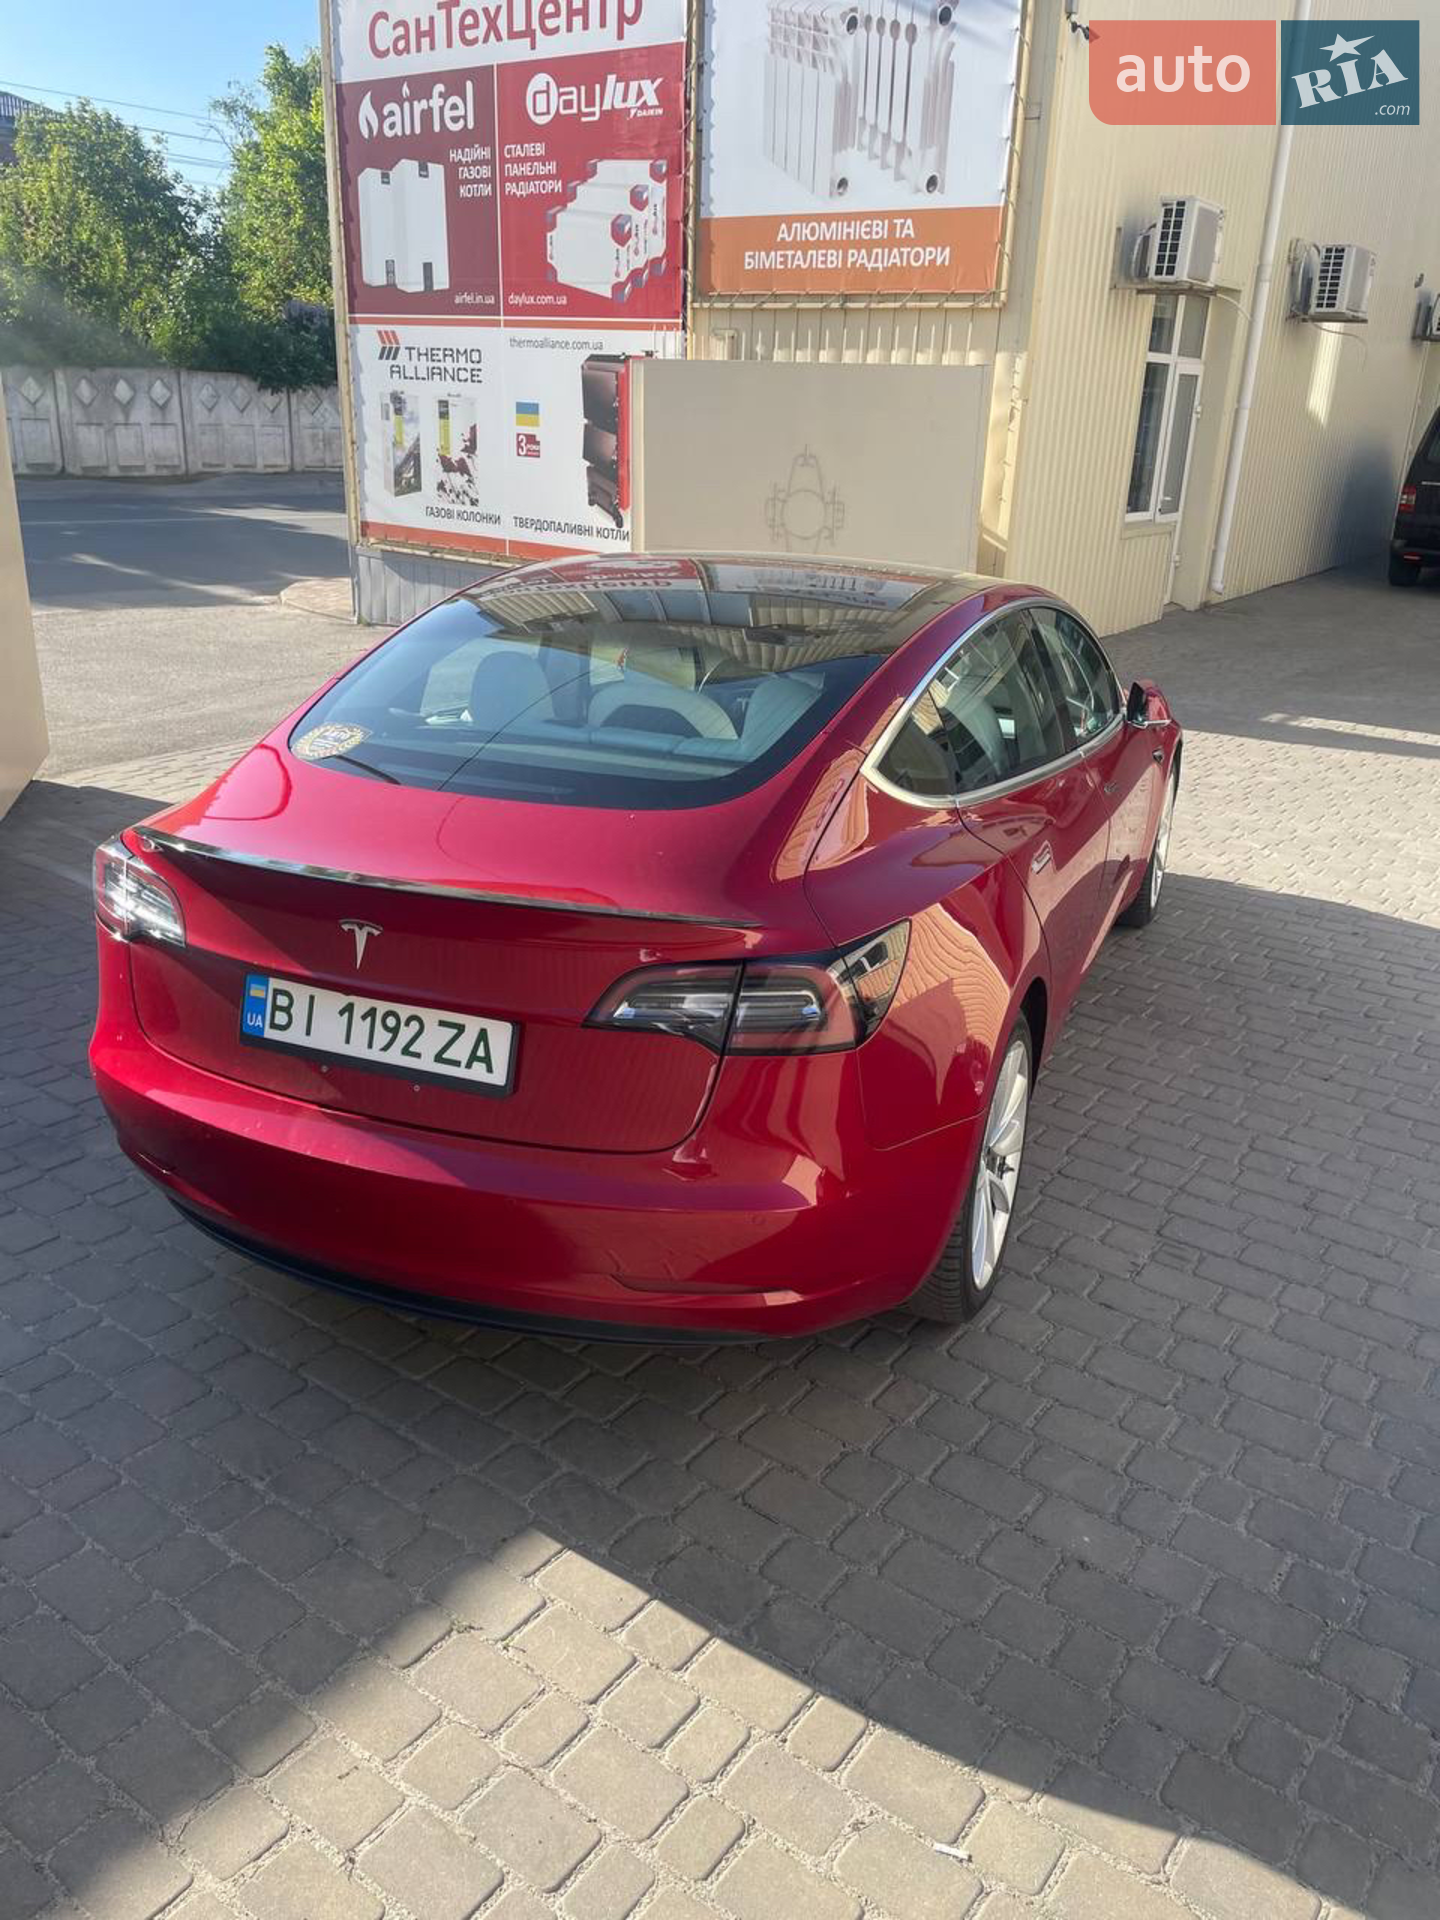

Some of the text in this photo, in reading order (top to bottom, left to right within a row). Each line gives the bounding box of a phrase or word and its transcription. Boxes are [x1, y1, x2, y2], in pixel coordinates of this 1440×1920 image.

[368, 0, 642, 59] СанТехЦентр
[526, 73, 663, 125] daylux
[382, 81, 474, 138] airfel
[449, 144, 491, 164] НАДІЙНІ
[503, 143, 545, 158] СТАЛЕВІ
[458, 166, 491, 179] ГАЗОВІ
[504, 161, 556, 177] ПАНЕЛЬНІ
[460, 183, 492, 198] КОТЛИ
[504, 179, 562, 198] РАДІАТОРИ
[776, 218, 915, 242] АЛЮМІНІЄВІ ТА
[743, 246, 950, 271] БІМЕТАЛЕВІ РАДІАТОРИ
[507, 292, 568, 306] daylux.com.ua
[509, 336, 603, 350] thermoalliance.com.ua
[404, 346, 482, 364] THERMO
[389, 364, 483, 384] ALLIANCE
[518, 434, 527, 455] 3
[425, 506, 501, 525] ГАЗОВІ КОЛОНКИ
[513, 516, 630, 542] ТВЕРДОПАЛИВНІ КОТЛИ
[246, 1012, 263, 1029] UA
[268, 988, 494, 1074] BI 1192 ZA
